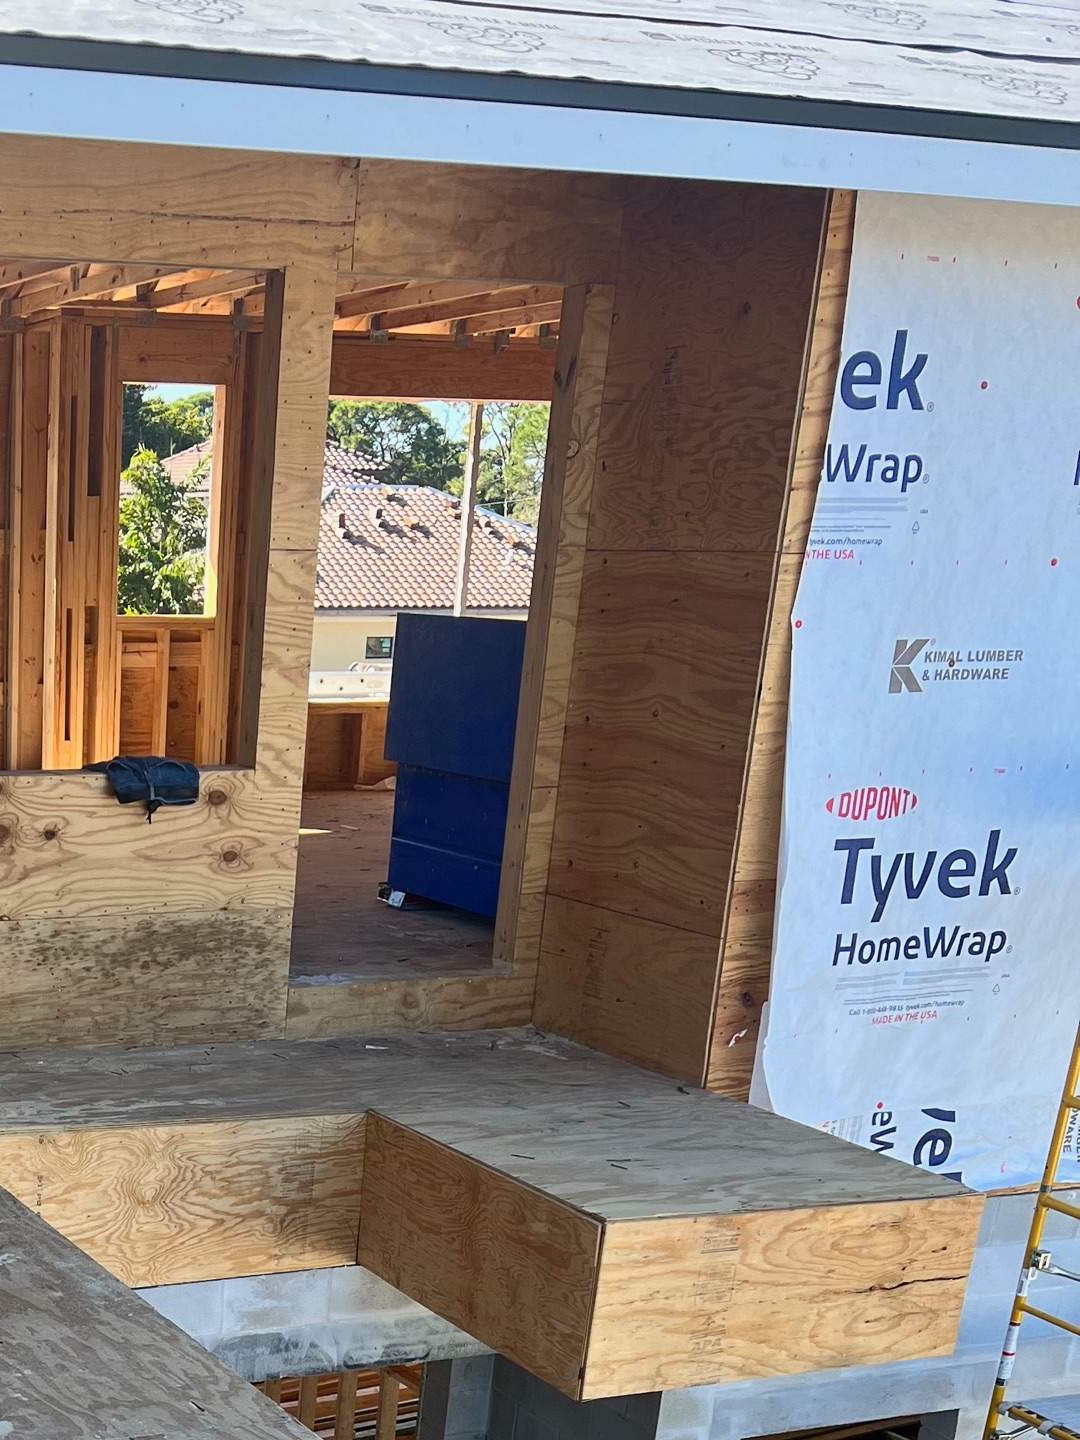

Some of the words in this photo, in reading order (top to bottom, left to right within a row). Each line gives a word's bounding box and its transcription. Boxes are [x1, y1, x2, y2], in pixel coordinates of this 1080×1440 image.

[812, 549, 831, 560] THE
[834, 549, 855, 560] USA
[924, 651, 963, 663] KIMAL
[967, 650, 1024, 662] LUMBER
[922, 669, 930, 681] &
[934, 668, 1010, 680] HARDWARE
[837, 786, 913, 820] DUPONT
[872, 1015, 893, 1025] MADE
[894, 1014, 903, 1023] IN
[905, 1012, 919, 1022] THE
[920, 1010, 938, 1021] USA
